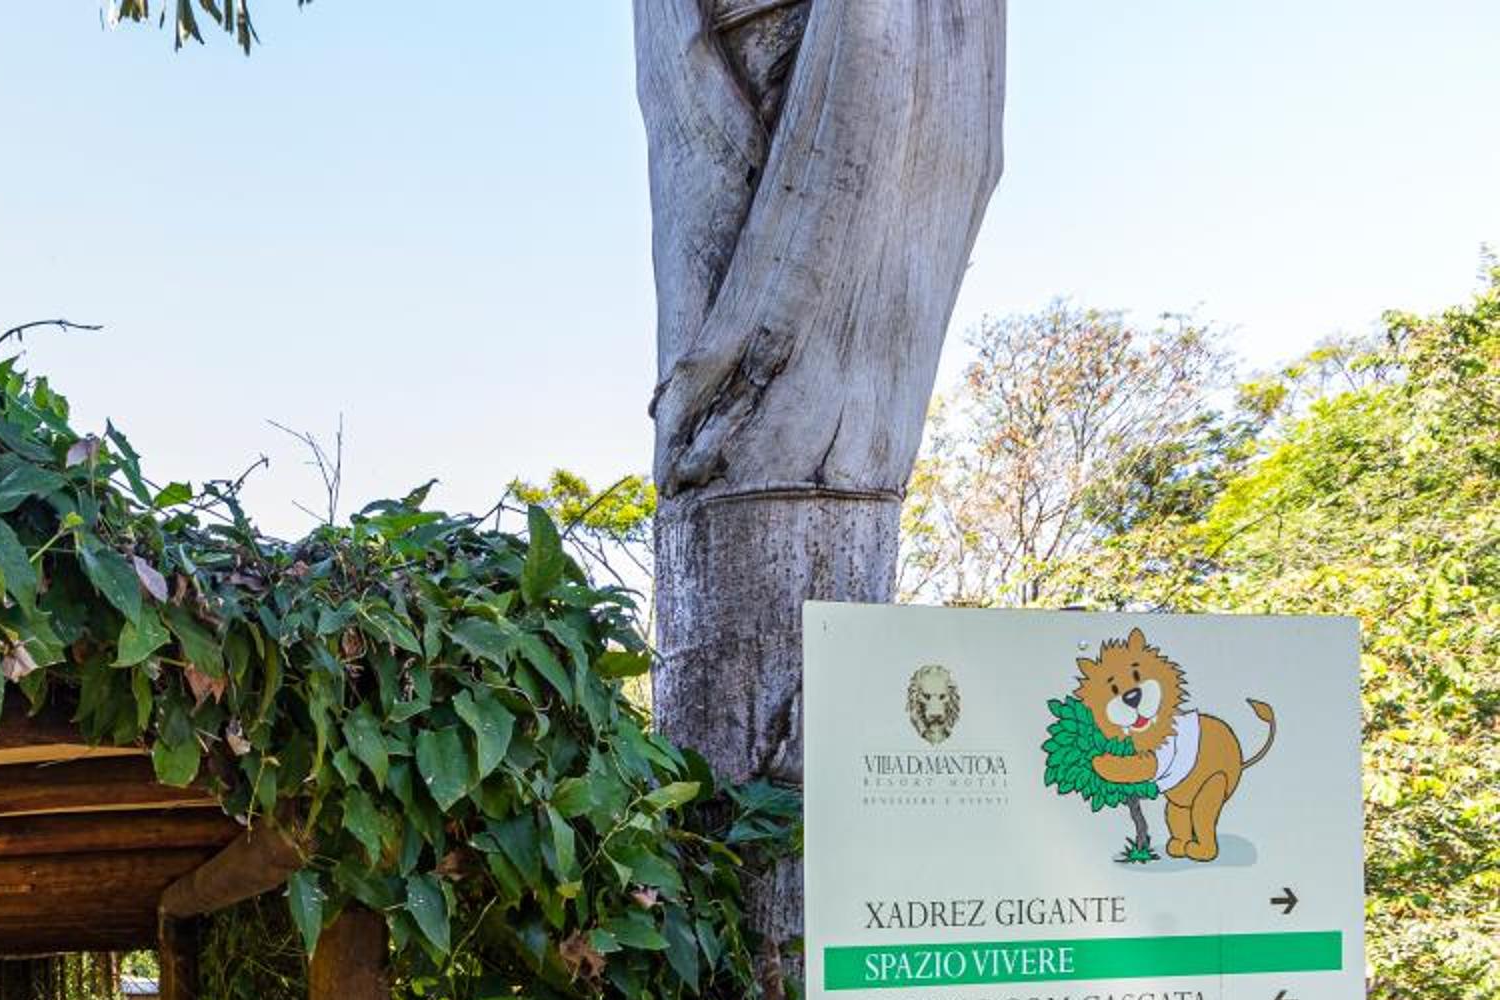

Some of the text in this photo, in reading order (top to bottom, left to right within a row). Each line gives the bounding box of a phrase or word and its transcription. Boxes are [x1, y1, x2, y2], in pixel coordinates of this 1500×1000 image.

[865, 896, 1127, 930] XADREZ GIGANTE
[864, 947, 1075, 982] SPAZIO VIVERE
